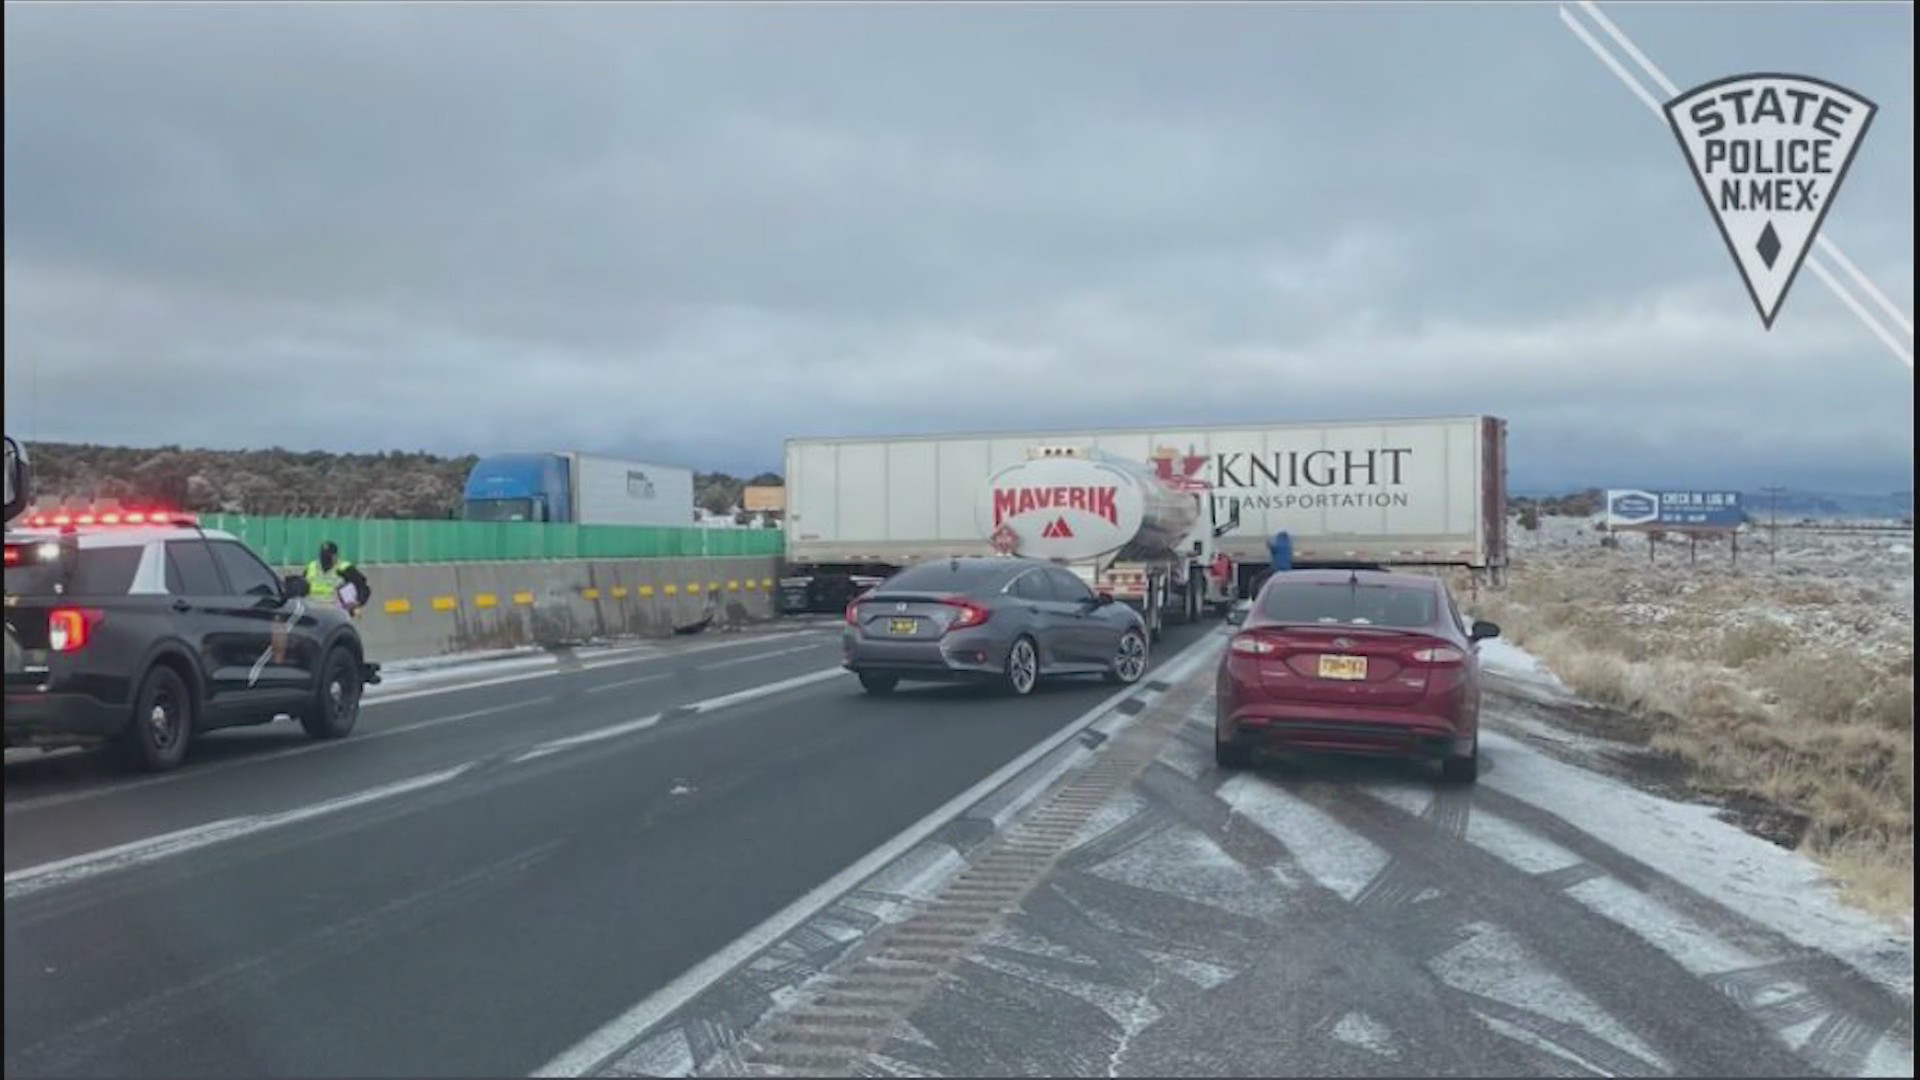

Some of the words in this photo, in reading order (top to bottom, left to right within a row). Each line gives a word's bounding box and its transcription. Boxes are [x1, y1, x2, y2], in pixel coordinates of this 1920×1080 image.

[1216, 448, 1412, 488] KNIGHT
[994, 486, 1118, 527] MAVERIK
[1216, 493, 1408, 509] TANSPORTATION
